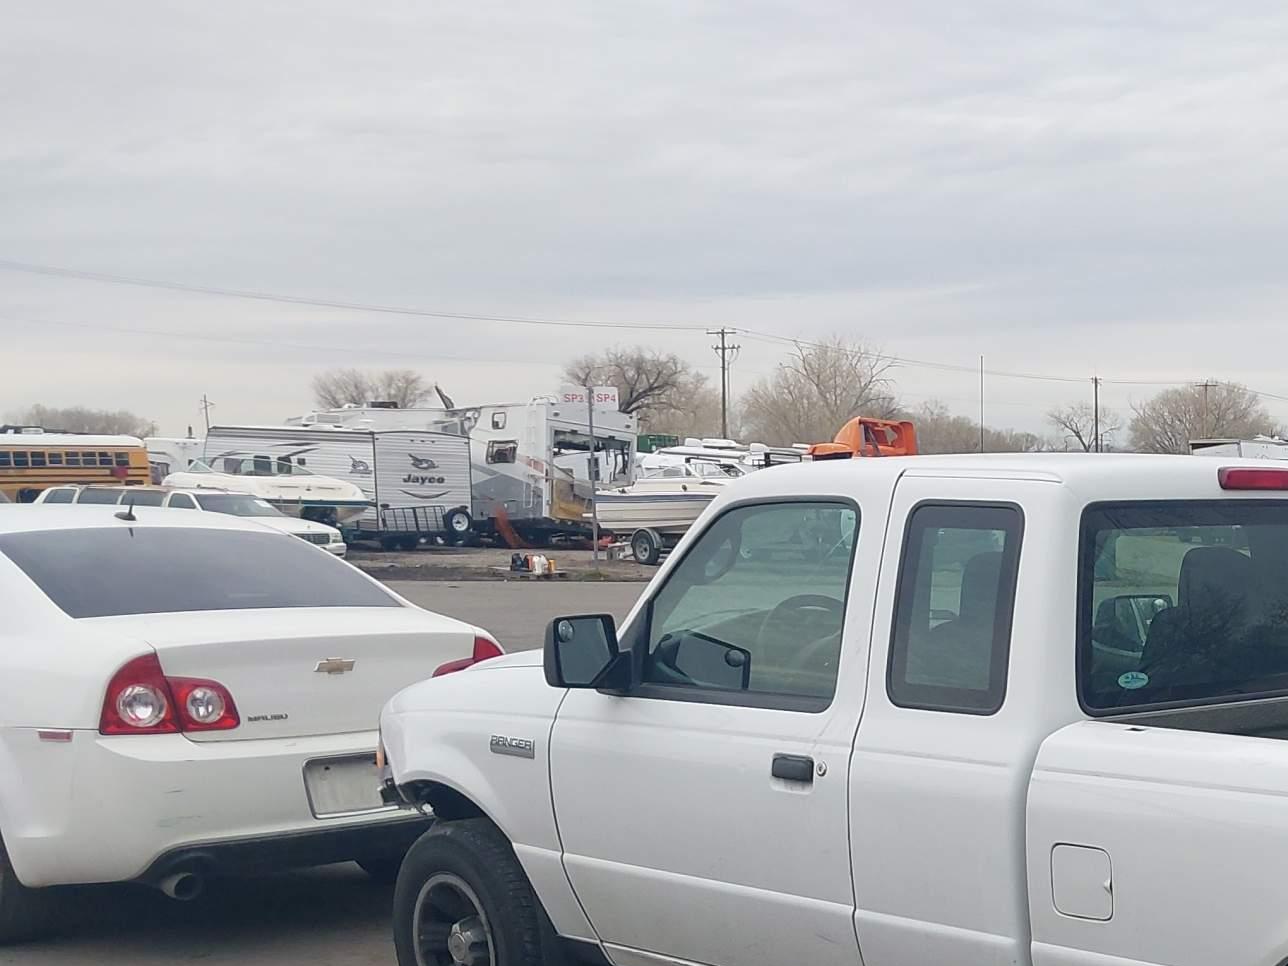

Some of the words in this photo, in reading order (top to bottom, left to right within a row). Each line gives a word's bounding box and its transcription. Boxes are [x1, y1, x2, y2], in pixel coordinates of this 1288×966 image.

[563, 393, 584, 403] SP3
[596, 393, 616, 403] SP4
[402, 474, 445, 485] Jayco
[490, 735, 532, 752] RANGER
